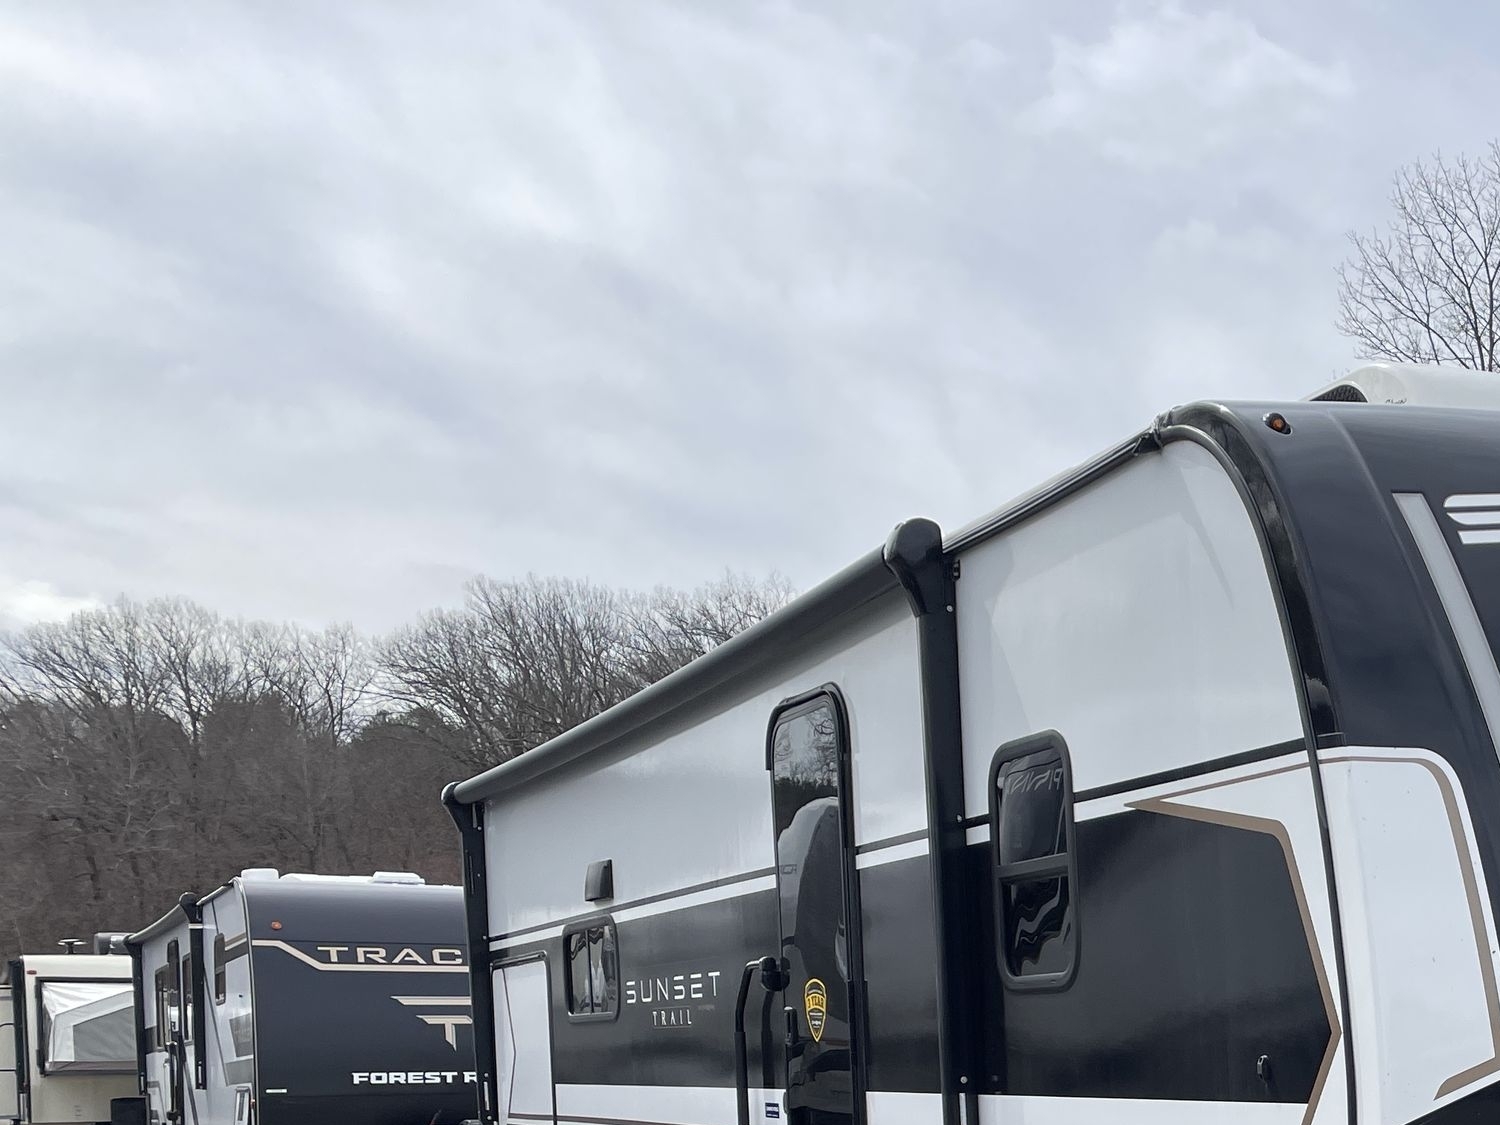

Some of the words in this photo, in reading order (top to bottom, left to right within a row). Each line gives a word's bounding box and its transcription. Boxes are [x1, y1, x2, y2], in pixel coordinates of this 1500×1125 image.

[317, 946, 463, 964] TRAC
[626, 971, 720, 1004] SUNSET
[652, 1009, 692, 1026] TRAIL
[352, 1072, 458, 1084] FOREST
